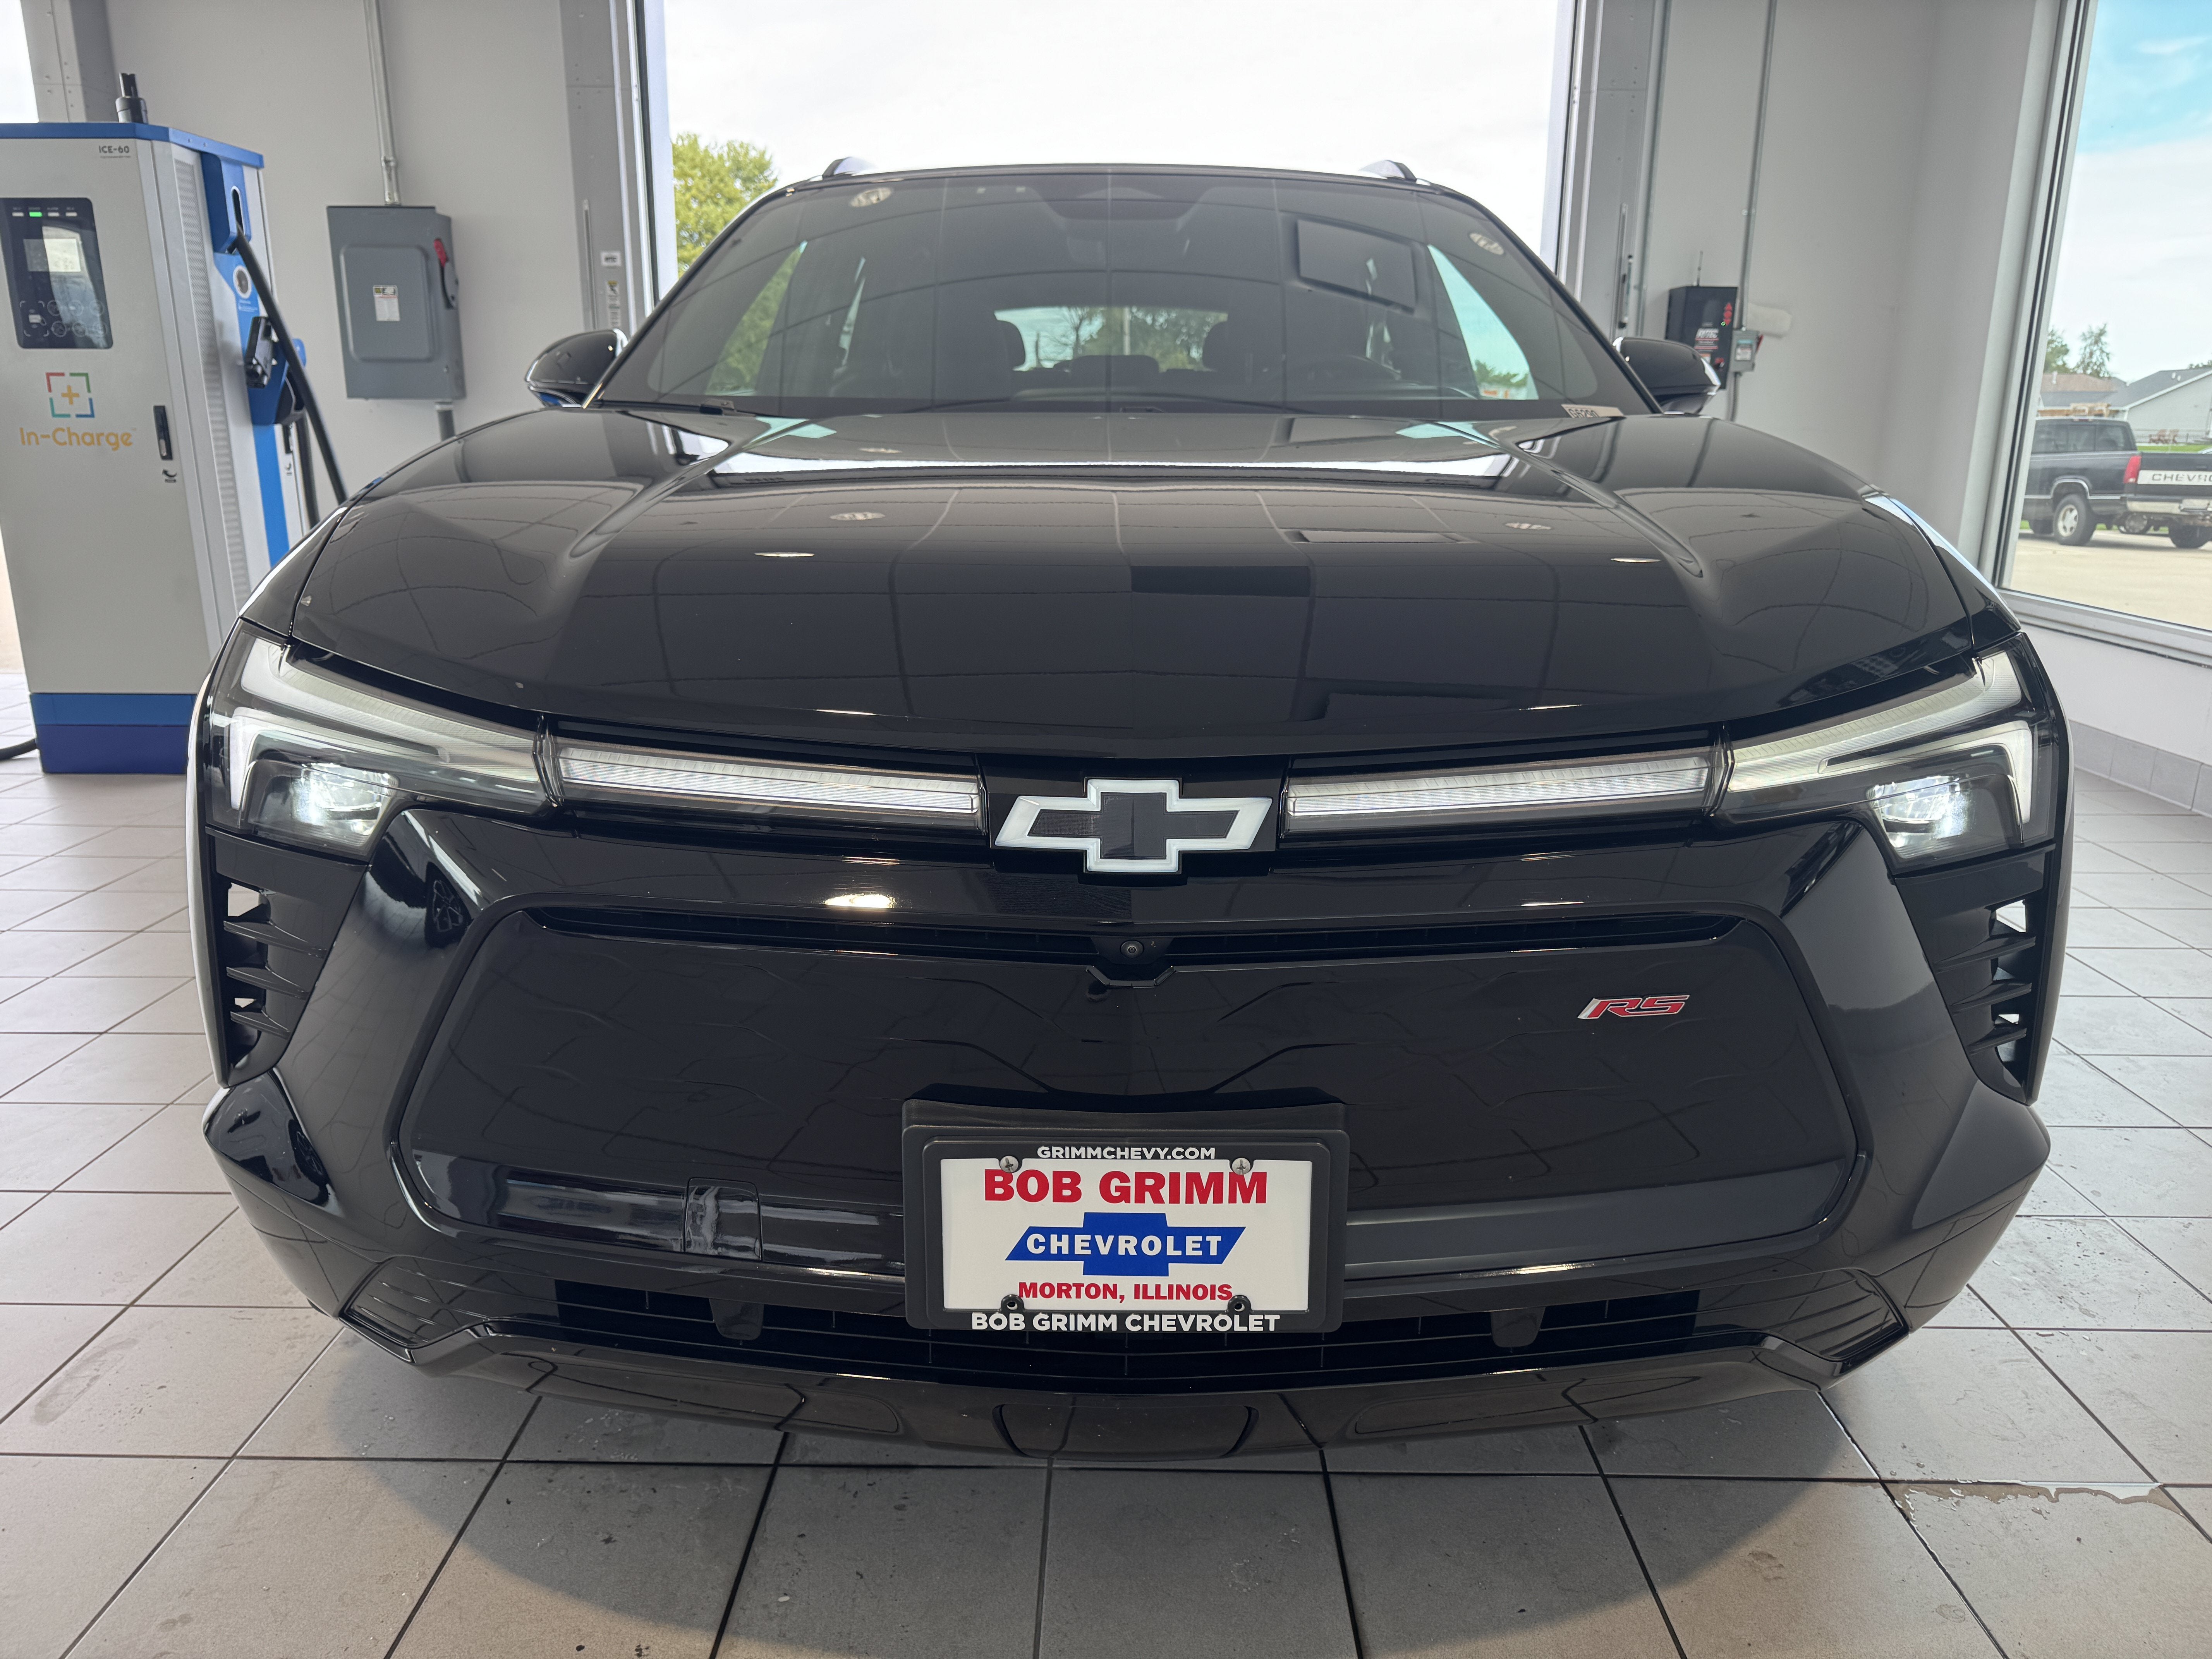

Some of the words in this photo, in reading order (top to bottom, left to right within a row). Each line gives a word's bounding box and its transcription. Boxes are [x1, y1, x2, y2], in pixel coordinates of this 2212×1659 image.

[98, 145, 130, 153] ICE-60
[19, 427, 133, 450] In-Charge
[1578, 995, 1690, 1019] RS
[1037, 1146, 1215, 1159] GRIMMCHEVY.COM
[985, 1169, 1082, 1202] BOB
[1099, 1171, 1267, 1204] GRIMM
[1027, 1233, 1221, 1255] CHEVROLET
[1019, 1282, 1125, 1303] MORTON,
[1134, 1284, 1233, 1300] ILLINOIS
[972, 1312, 1025, 1330] BOB
[1032, 1313, 1118, 1331] GRIMM
[1125, 1314, 1280, 1331] CHEVROLET
